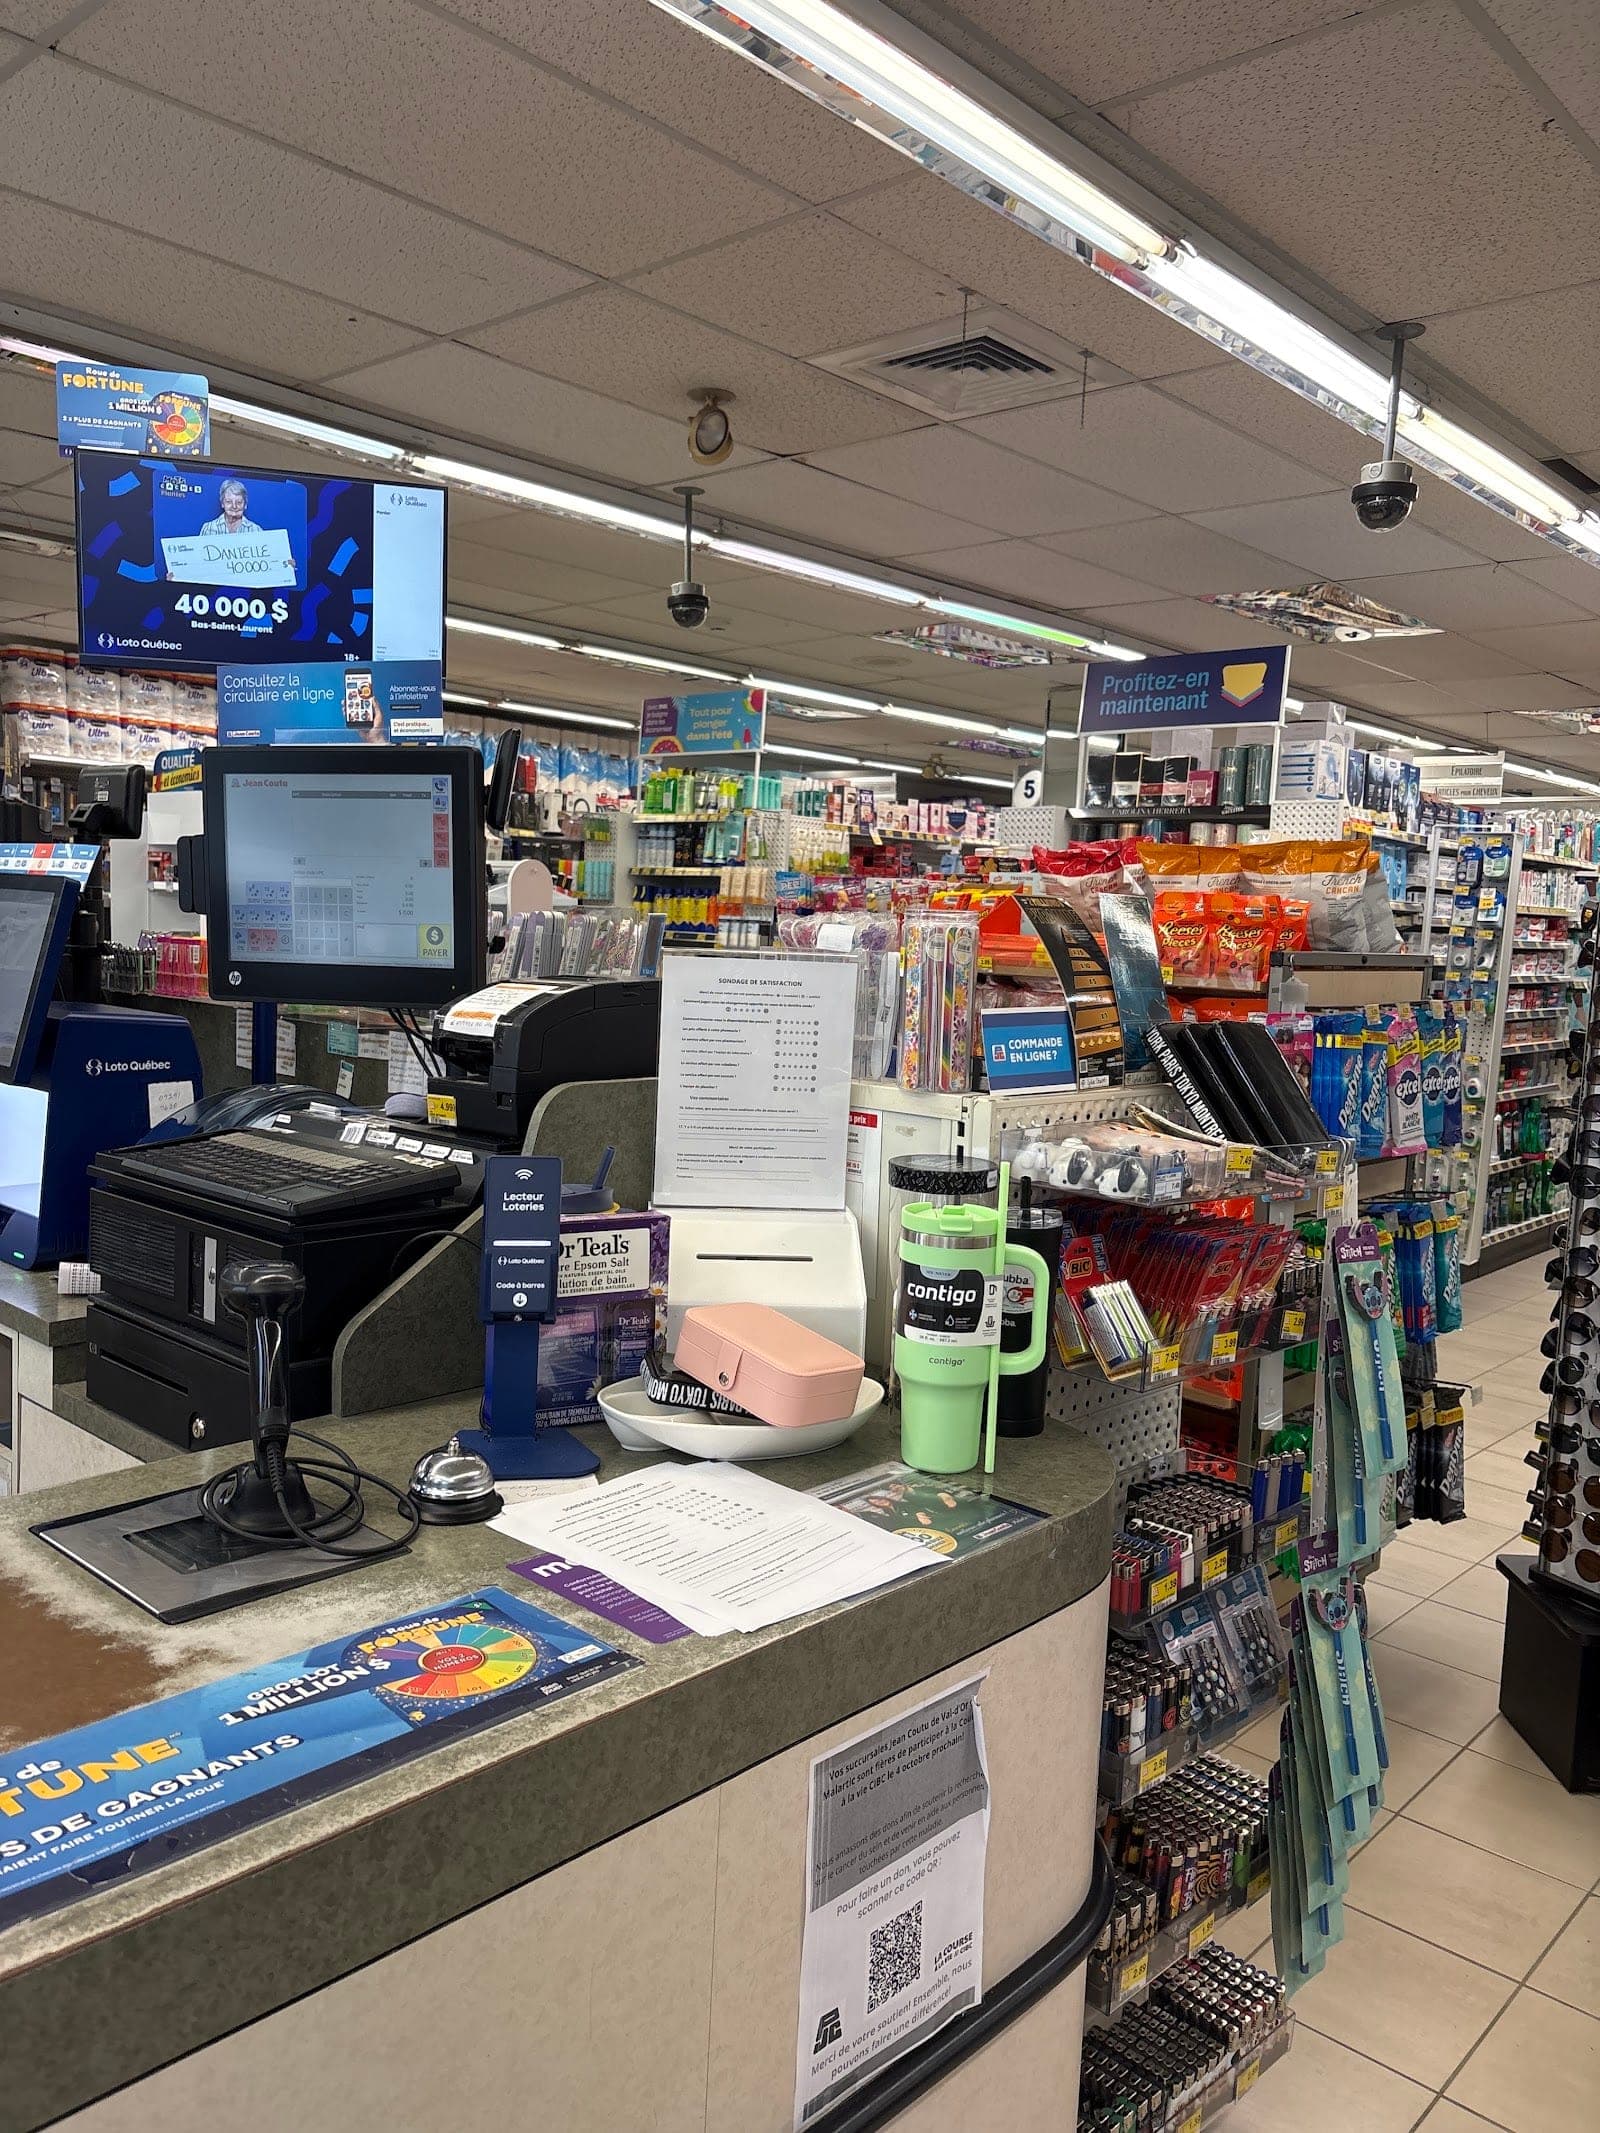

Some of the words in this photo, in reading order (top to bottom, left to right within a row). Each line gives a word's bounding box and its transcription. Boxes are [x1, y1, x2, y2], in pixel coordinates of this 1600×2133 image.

[86, 367, 107, 377] Roue
[109, 370, 120, 378] de
[62, 373, 145, 394] FORTUNE
[115, 402, 155, 414] MILLION
[103, 419, 142, 428] GAGNANTS
[203, 544, 271, 561] DANIELLE
[174, 593, 210, 615] 40
[214, 596, 266, 619] 000
[271, 598, 289, 623] $
[191, 620, 273, 634] Bas-Saint-Laurent
[117, 636, 140, 648] Loto
[141, 638, 183, 651] Québec
[344, 653, 360, 662] 18+
[223, 674, 285, 689] Consultez
[288, 673, 300, 686] la
[1102, 670, 1210, 695] Profitez-en
[224, 688, 280, 703] circulaire
[282, 690, 300, 701] en
[302, 687, 335, 704] ligne
[1100, 690, 1209, 715] maintenant
[690, 708, 709, 718] Tout
[711, 707, 733, 717] pour
[693, 719, 728, 730] plonger
[686, 732, 710, 741] dans
[711, 730, 733, 739] l'été
[161, 752, 196, 770] QUALITÉ
[243, 779, 263, 787] Jean
[263, 779, 288, 788] Coutu
[1023, 780, 1035, 799] 5
[1152, 807, 1192, 815] HERRERA
[1207, 875, 1241, 887] French
[1322, 874, 1363, 887] French
[1325, 886, 1360, 895] CANCAN
[1158, 922, 1205, 936] Reese's
[1216, 924, 1262, 938] Reese's
[422, 949, 448, 957] PAYER
[230, 971, 241, 985] hp
[759, 979, 803, 987] SATISFACTION
[1008, 1036, 1063, 1049] COMMANDE
[1011, 1051, 1025, 1063] EN
[105, 1061, 128, 1072] Loto
[130, 1059, 171, 1072] Québec
[1146, 1026, 1167, 1058] YORK
[1160, 1049, 1183, 1078] PARIS
[1174, 1072, 1200, 1105] TOKYO
[1362, 1050, 1389, 1122] Dentyne
[1396, 1075, 1421, 1098] excel
[1422, 1074, 1444, 1091] excel
[1338, 1054, 1364, 1129] Dentyne
[503, 1192, 544, 1201] Lecteur
[502, 1202, 545, 1211] Loteries
[577, 1234, 629, 1257] Teal's
[574, 1260, 607, 1272] Epsom
[610, 1257, 629, 1267] Salt
[516, 1281, 521, 1289] à
[591, 1277, 603, 1286] de
[606, 1275, 628, 1285] bain
[907, 1282, 976, 1307] contigo
[928, 1356, 965, 1367] contigo
[1165, 1351, 1179, 1363] 7.99
[670, 1384, 708, 1407] TOKYO
[1439, 1425, 1464, 1497] Dentyne
[1214, 1558, 1226, 1571] 2.29
[357, 1612, 485, 1655] FORTUNE
[386, 1622, 420, 1635] Roue
[437, 1655, 458, 1663] VOS
[247, 1677, 304, 1701] GROS
[304, 1663, 340, 1681] LOT
[218, 1713, 243, 1727] 1
[241, 1665, 371, 1718] MILLION
[369, 1658, 391, 1671] $
[845, 1743, 888, 1773] succursales
[889, 1735, 906, 1751] Jean
[907, 1723, 929, 1738] Coutu
[930, 1716, 940, 1727] de
[940, 1702, 968, 1722] Val-d'Or
[875, 1754, 896, 1773] fières
[908, 1731, 944, 1756] participer
[902, 1752, 930, 1773] octobre
[1154, 1758, 1167, 1772] 2.99
[15, 1760, 62, 1781] de
[31, 1812, 93, 1845] DE
[96, 1734, 302, 1818] GAGNANTS
[50, 1832, 94, 1855] FAIRE
[96, 1802, 166, 1835] TOURNER
[167, 1794, 185, 1808] LA
[857, 1893, 893, 1919] scanner
[906, 1870, 926, 1886] code
[836, 1896, 858, 1916] Pour
[934, 1952, 942, 1965] LA
[943, 1931, 973, 1955] COURSE
[1133, 1963, 1147, 1979] 2.89
[811, 2049, 837, 2077] Merci
[838, 2044, 850, 2057] de
[852, 2027, 875, 2048] votre
[878, 2002, 911, 2033] soutien!
[913, 1973, 951, 2008] Ensemble,
[952, 1960, 972, 1975] nous
[831, 2047, 869, 2080] pouvons
[872, 2031, 892, 2050] faire
[894, 2021, 910, 2036] une
[911, 1985, 952, 2023] différence!
